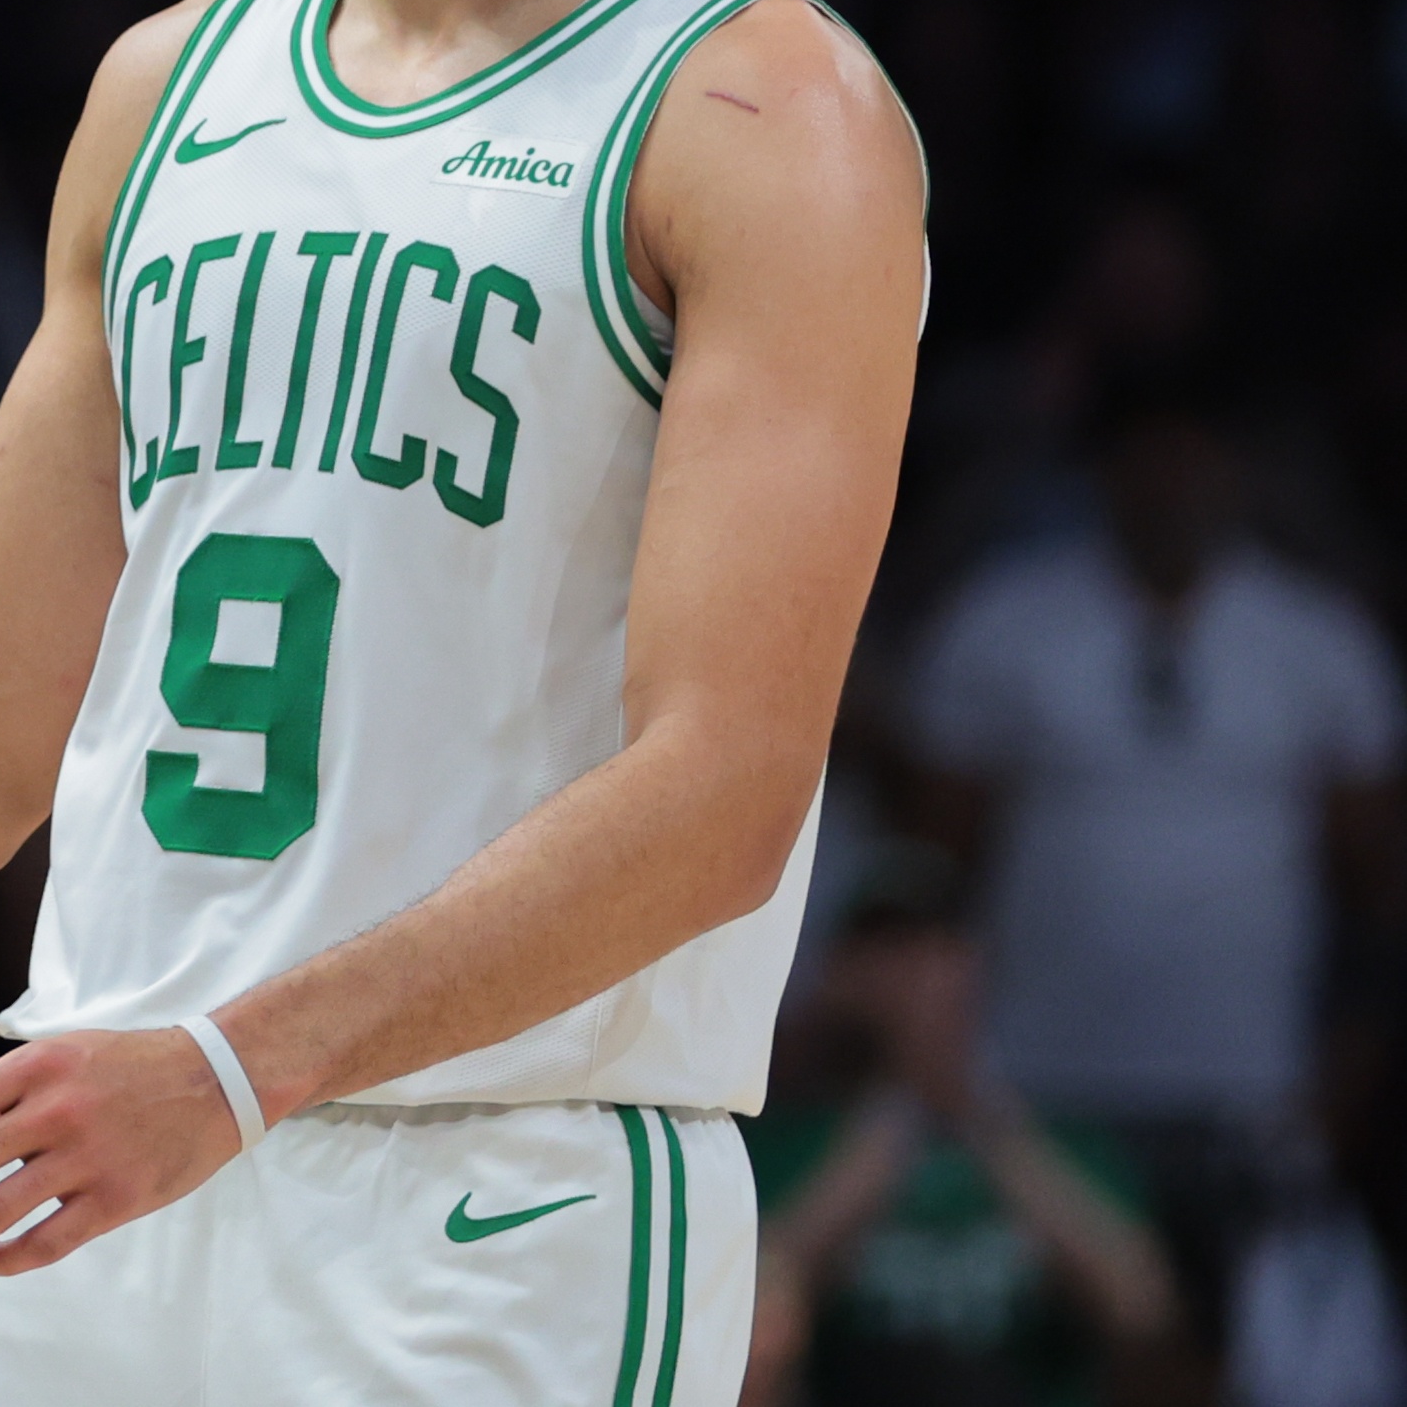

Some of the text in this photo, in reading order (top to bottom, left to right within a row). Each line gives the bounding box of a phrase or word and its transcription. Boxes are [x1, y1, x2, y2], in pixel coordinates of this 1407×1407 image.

[441, 139, 575, 188] Amica
[120, 230, 542, 529] CELTICS
[141, 531, 341, 861] 9
